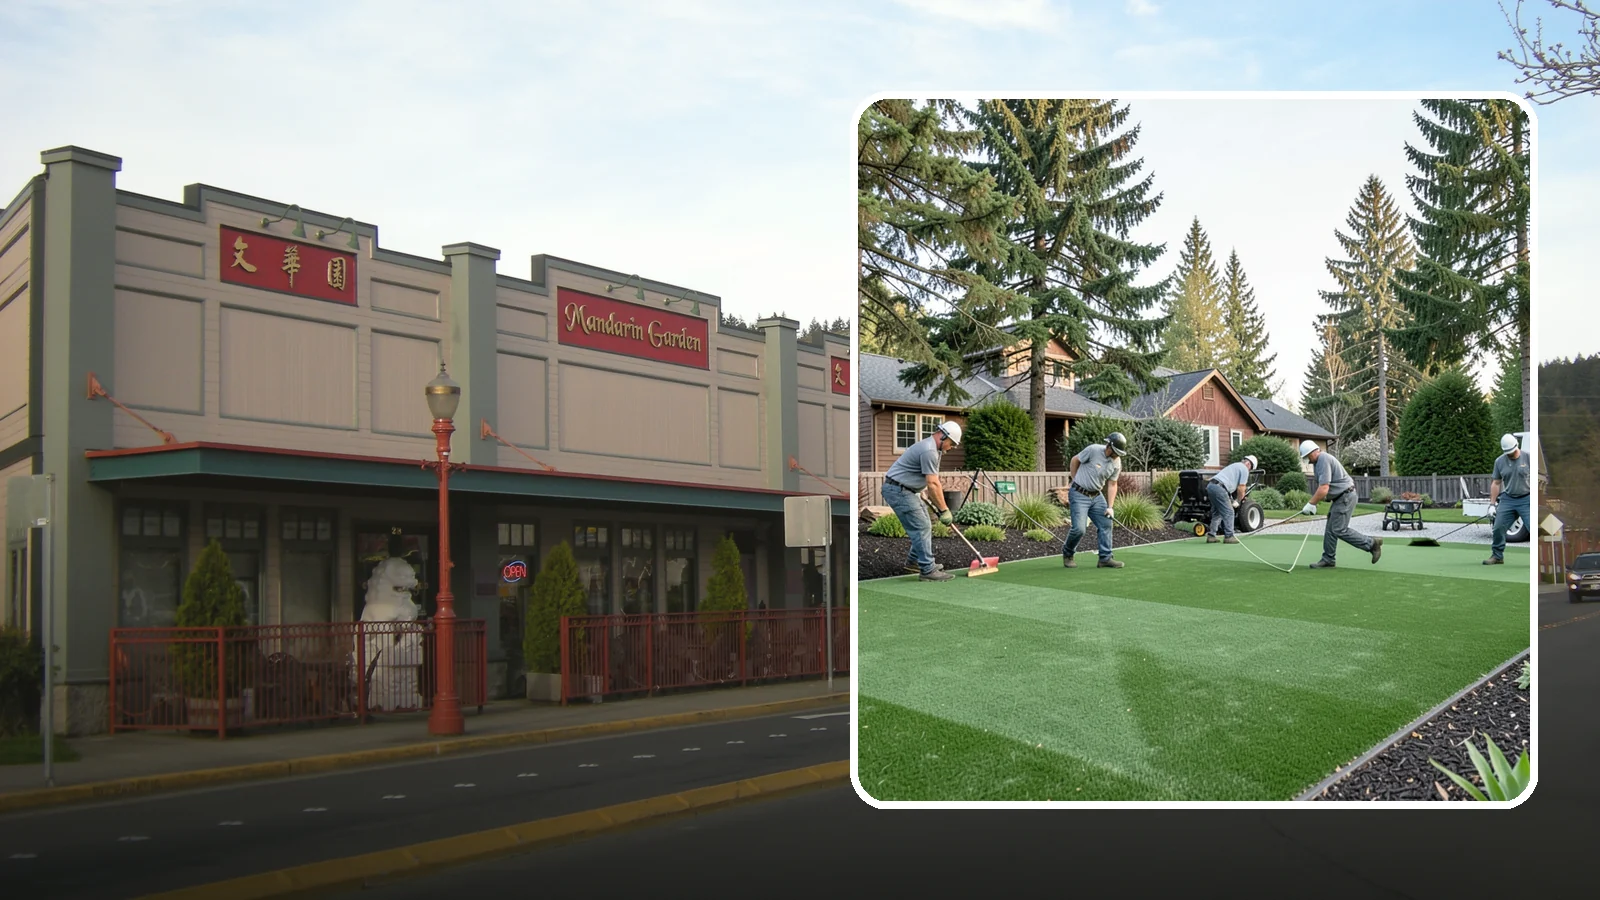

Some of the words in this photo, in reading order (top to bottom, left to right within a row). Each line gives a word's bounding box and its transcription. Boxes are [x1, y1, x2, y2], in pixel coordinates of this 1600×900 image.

[231, 236, 346, 291] 文華園
[564, 302, 644, 341] Mandarin
[648, 320, 701, 352] Garden
[503, 565, 527, 578] OPEN
